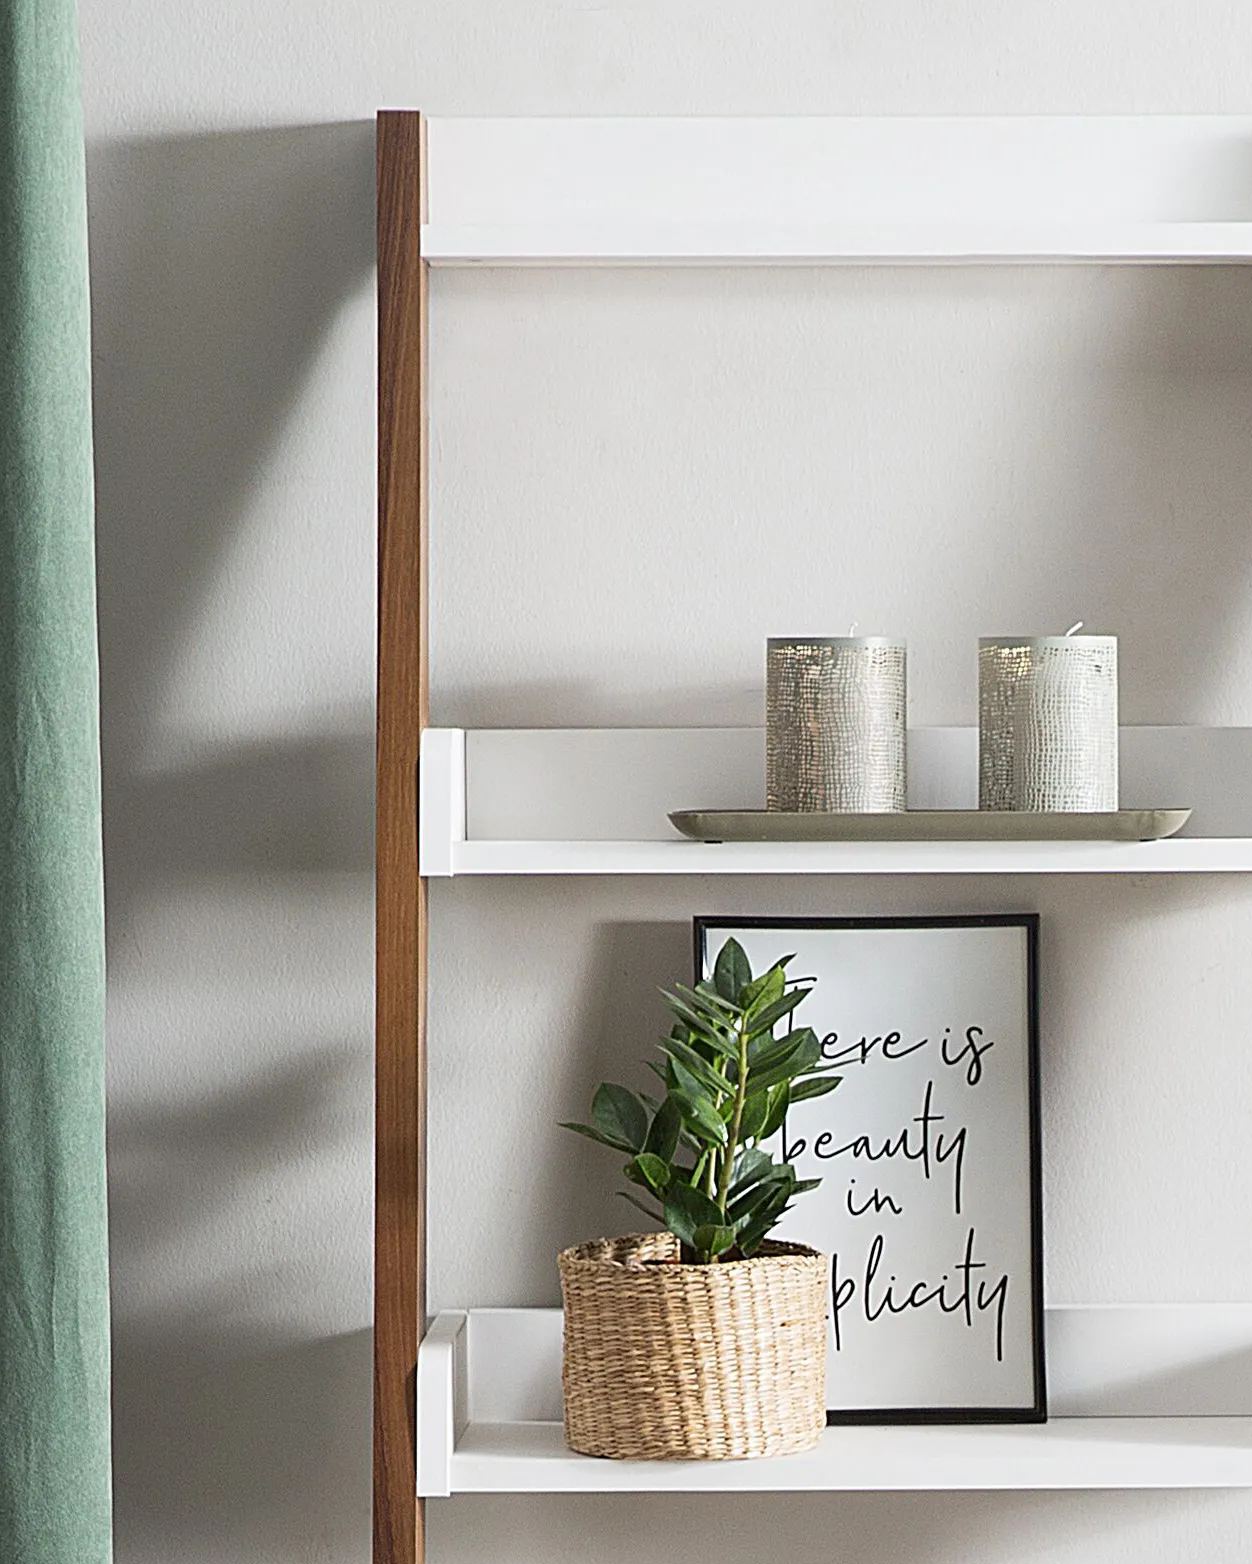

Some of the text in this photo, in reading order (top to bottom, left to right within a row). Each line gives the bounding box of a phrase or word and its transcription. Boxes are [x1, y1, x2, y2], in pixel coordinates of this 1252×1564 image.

[942, 1025, 995, 1086] is
[782, 1080, 967, 1215] beauty
[847, 1178, 903, 1216] in
[825, 1227, 1009, 1362] plicity
